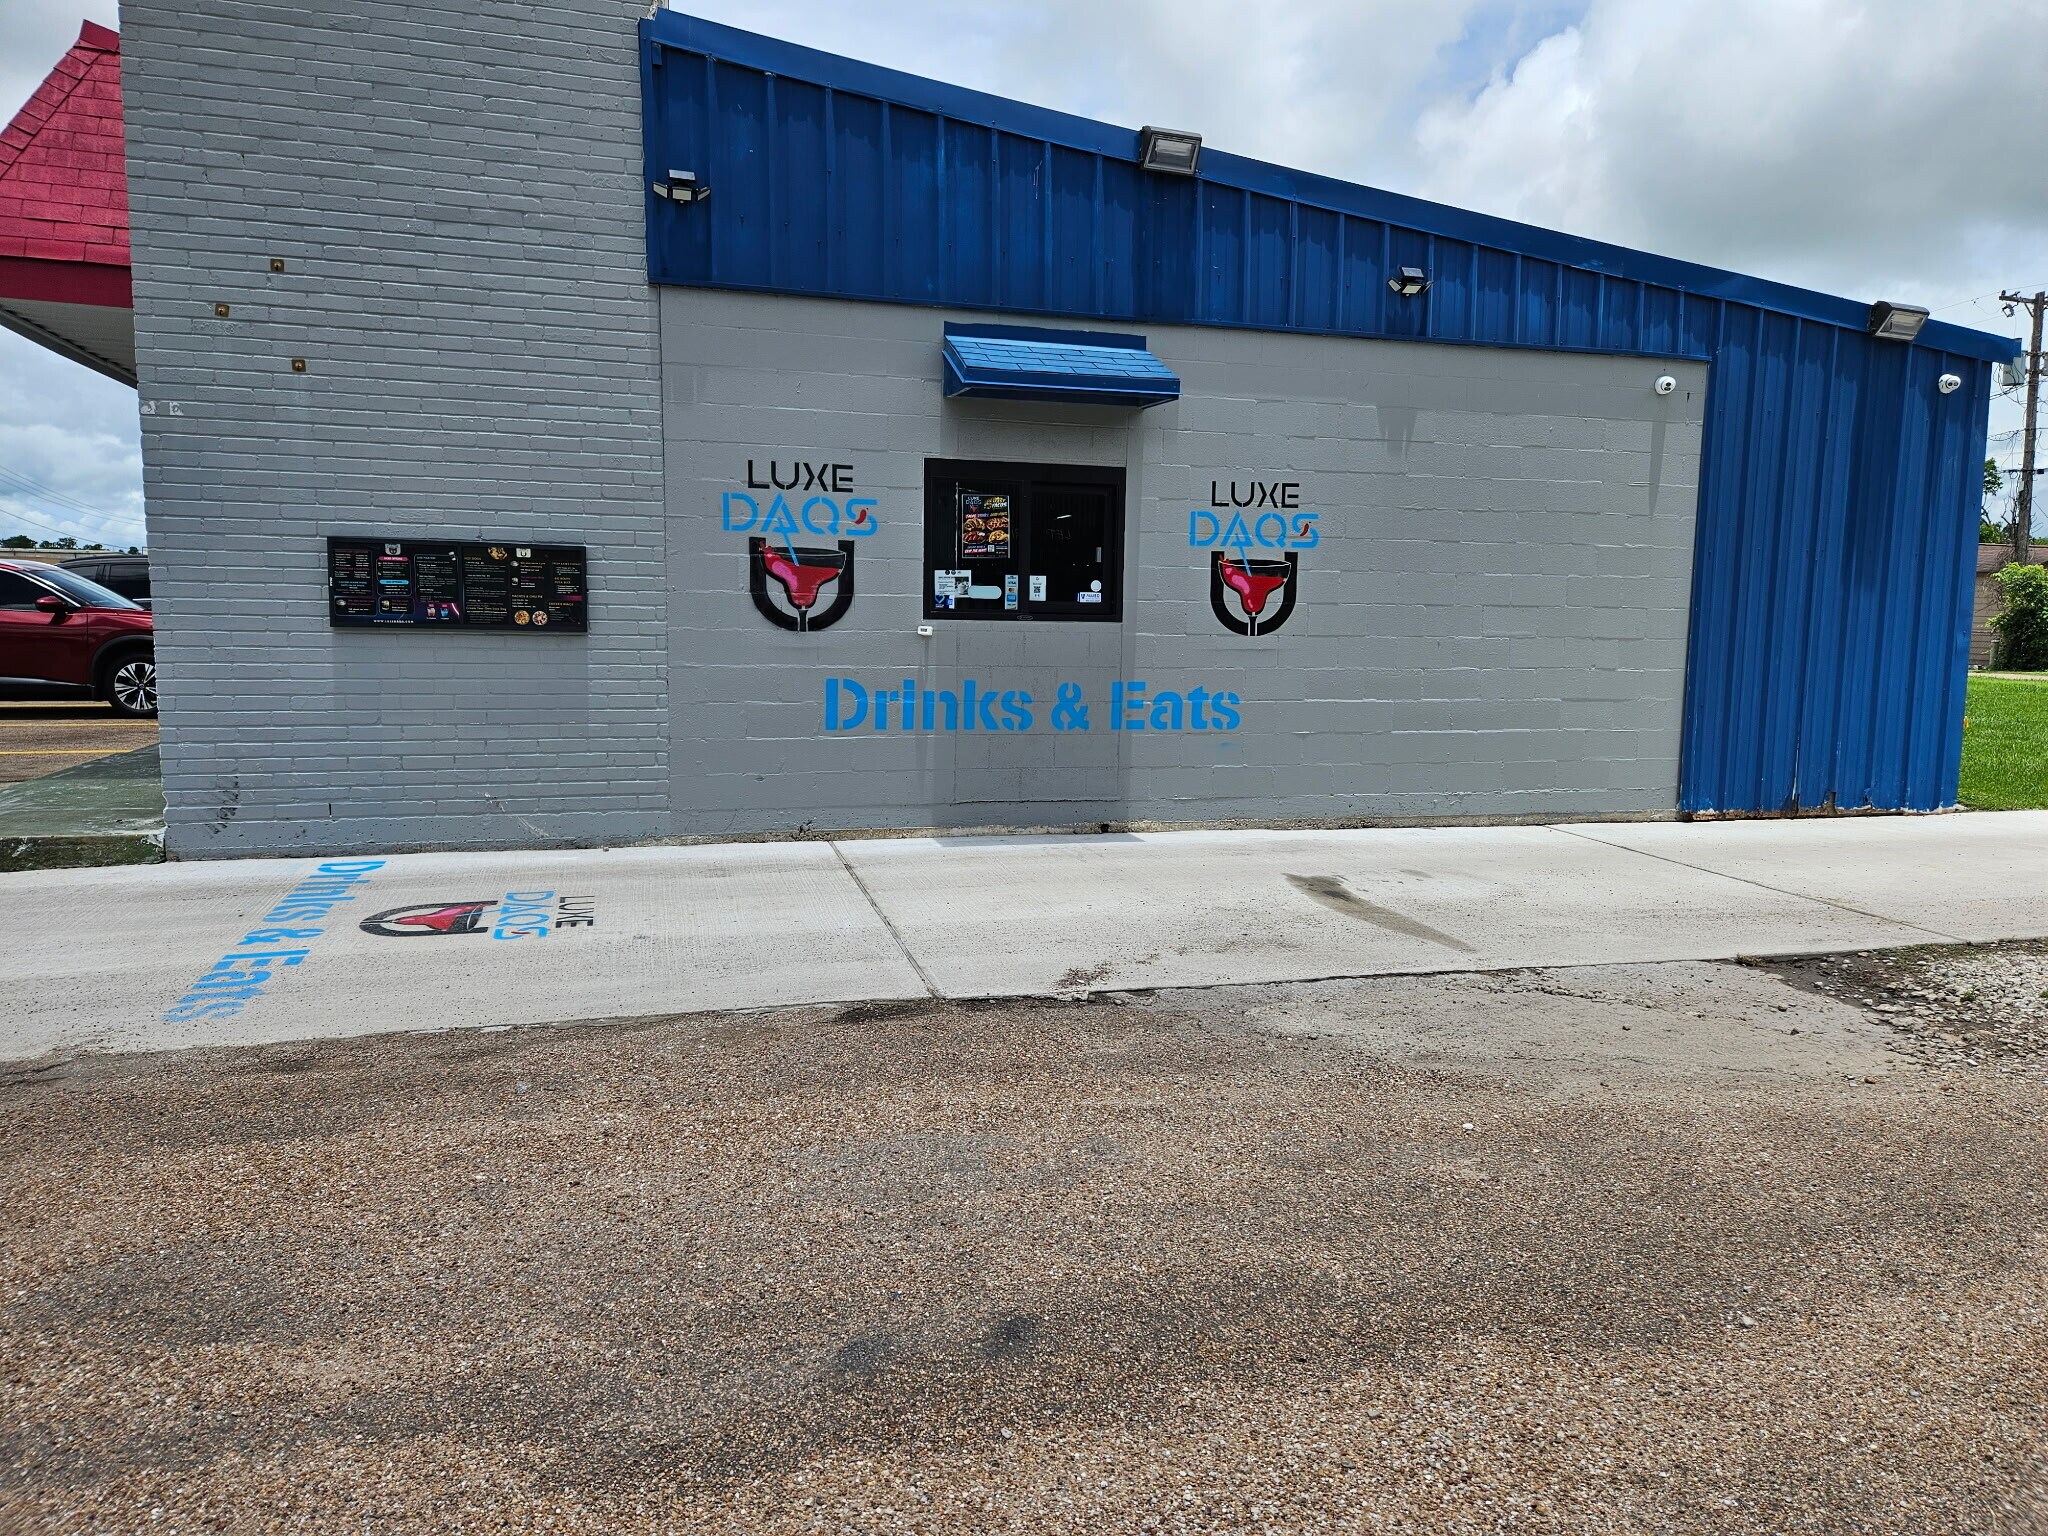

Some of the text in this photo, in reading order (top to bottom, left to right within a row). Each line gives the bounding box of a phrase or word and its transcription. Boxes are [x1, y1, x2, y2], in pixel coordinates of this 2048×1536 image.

[747, 459, 854, 493] LUXE
[1211, 480, 1300, 509] LUXE
[722, 491, 879, 537] DAQS
[1189, 510, 1321, 549] DAQS
[825, 678, 1242, 731] Drinks & Eats
[492, 890, 555, 941] DAQS
[555, 895, 595, 929] LUXE
[162, 860, 387, 1023] Drinks & Eats
